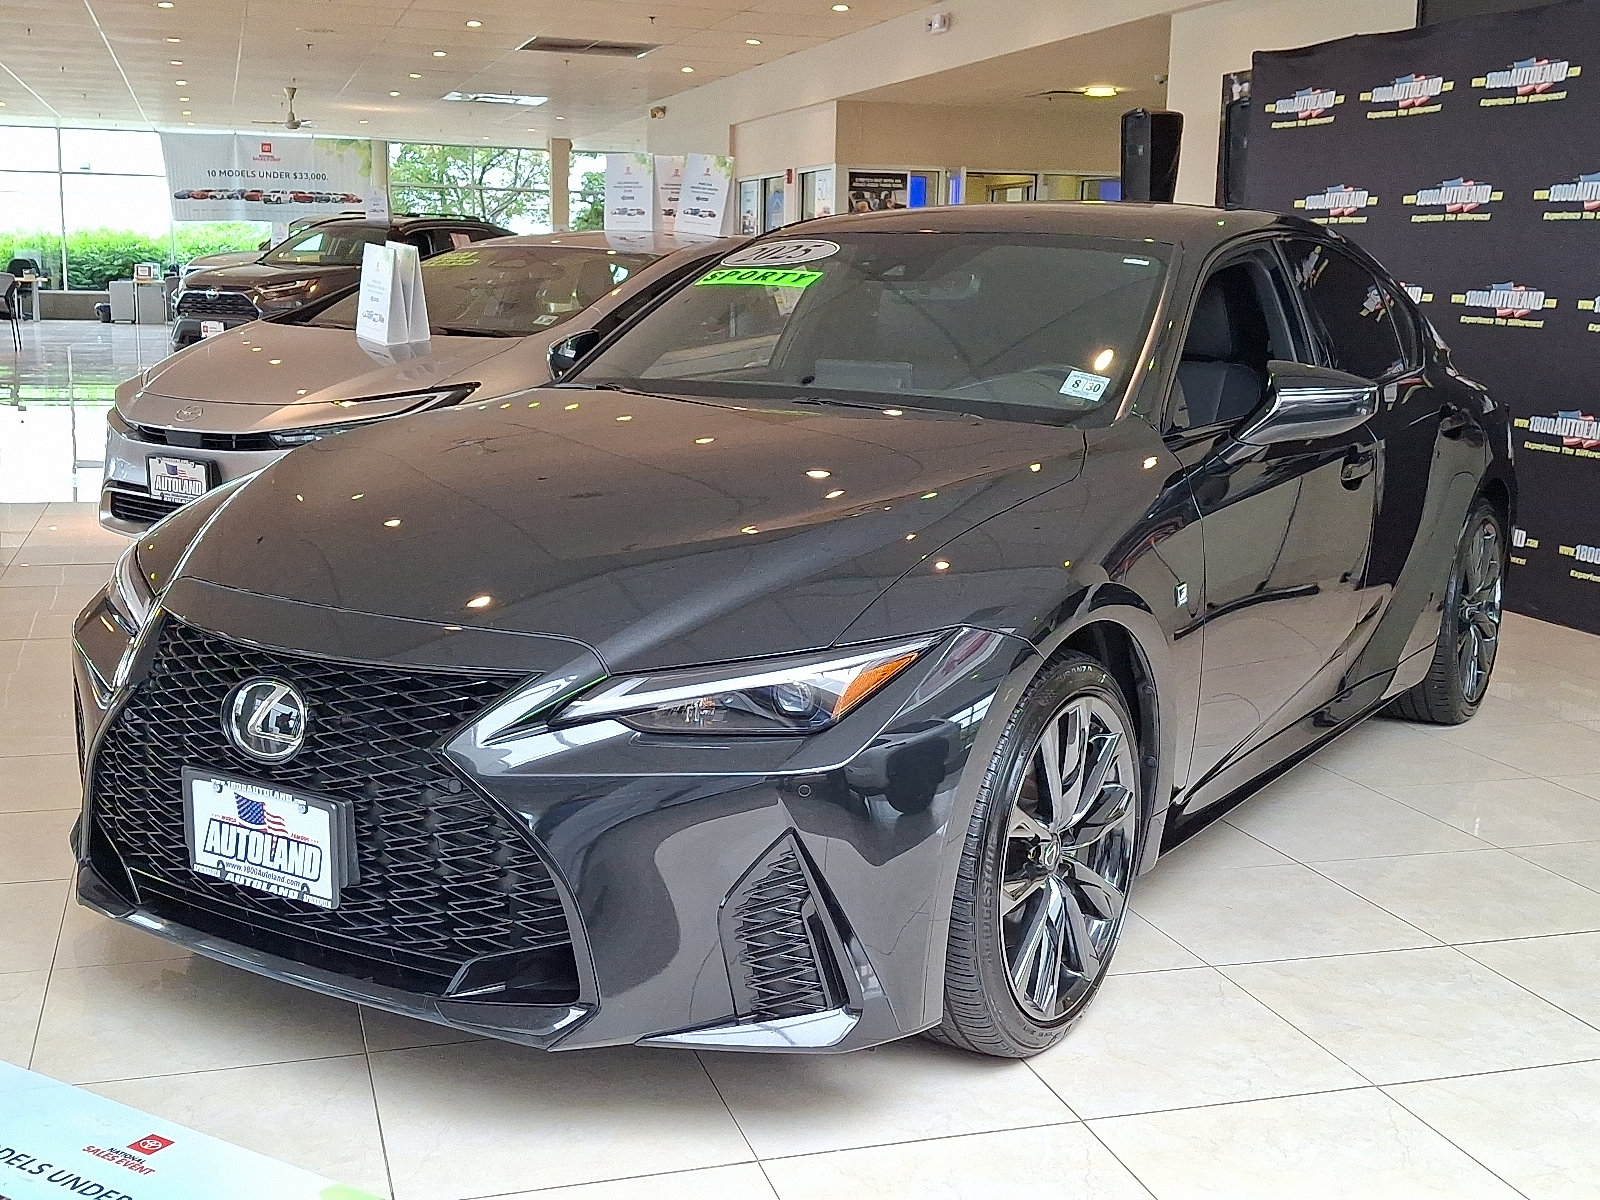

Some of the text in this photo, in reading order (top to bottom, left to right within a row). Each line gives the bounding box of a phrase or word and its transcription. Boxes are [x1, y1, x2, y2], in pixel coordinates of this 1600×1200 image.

[219, 170, 256, 178] MODELS
[258, 171, 290, 179] UNDER
[292, 172, 328, 180] $33,000.
[734, 243, 826, 262] 2025
[703, 270, 817, 283] SPORTY
[155, 475, 203, 496] AUTOLAND
[203, 818, 323, 882] AUTOLAND
[225, 861, 301, 887] www.1800Autoland.com
[225, 872, 299, 900] AUTOLAND
[82, 1145, 155, 1175] SALES EVENT
[107, 1147, 148, 1165] NATIONAL
